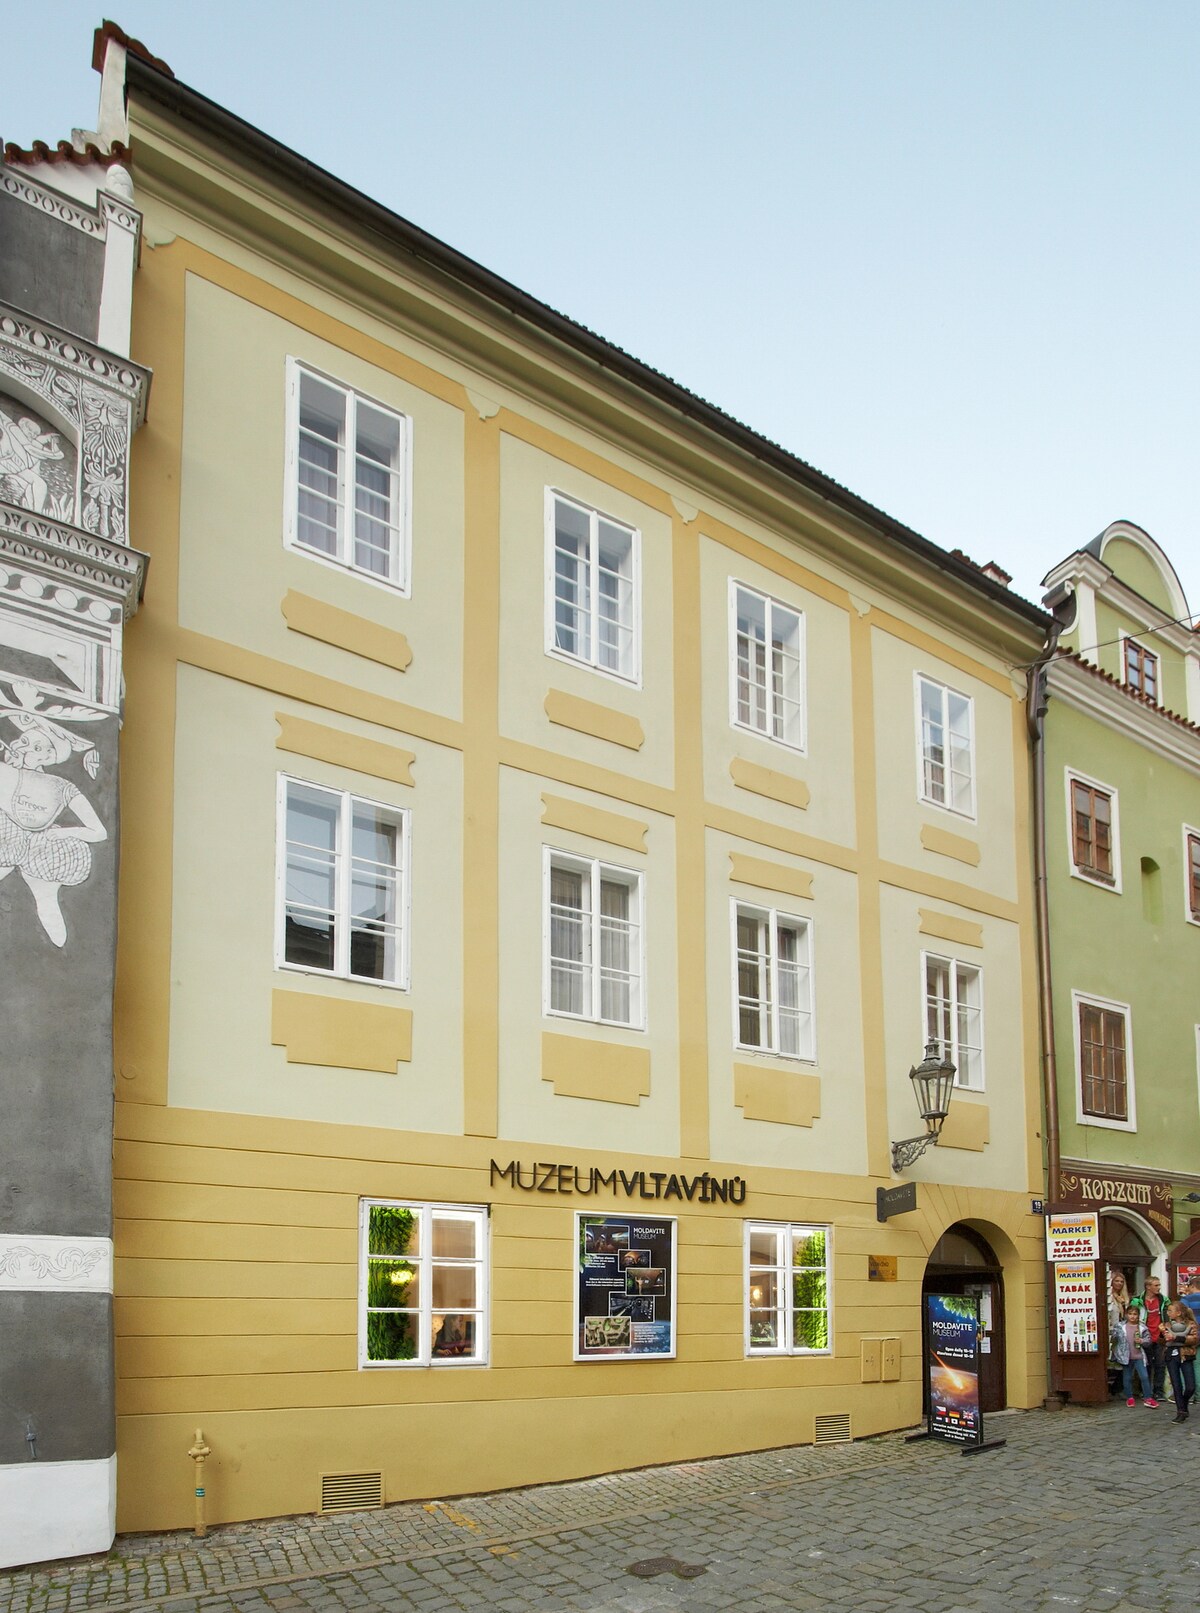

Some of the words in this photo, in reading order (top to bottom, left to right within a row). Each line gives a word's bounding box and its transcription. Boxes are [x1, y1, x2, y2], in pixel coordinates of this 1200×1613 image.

[490, 1158, 617, 1197] MUZEUM
[1079, 1177, 1152, 1205] KONZUM
[633, 1227, 665, 1235] MOLDAVITE
[1052, 1226, 1093, 1235] MARKET
[1054, 1238, 1091, 1247] TABÁK
[1053, 1246, 1093, 1254] NÁPOJE
[1059, 1283, 1091, 1293] TABÁK
[1058, 1296, 1093, 1305] NÁPOJE
[932, 1321, 973, 1332] MOLDAVITE
[932, 1328, 961, 1338] MUSEUM
